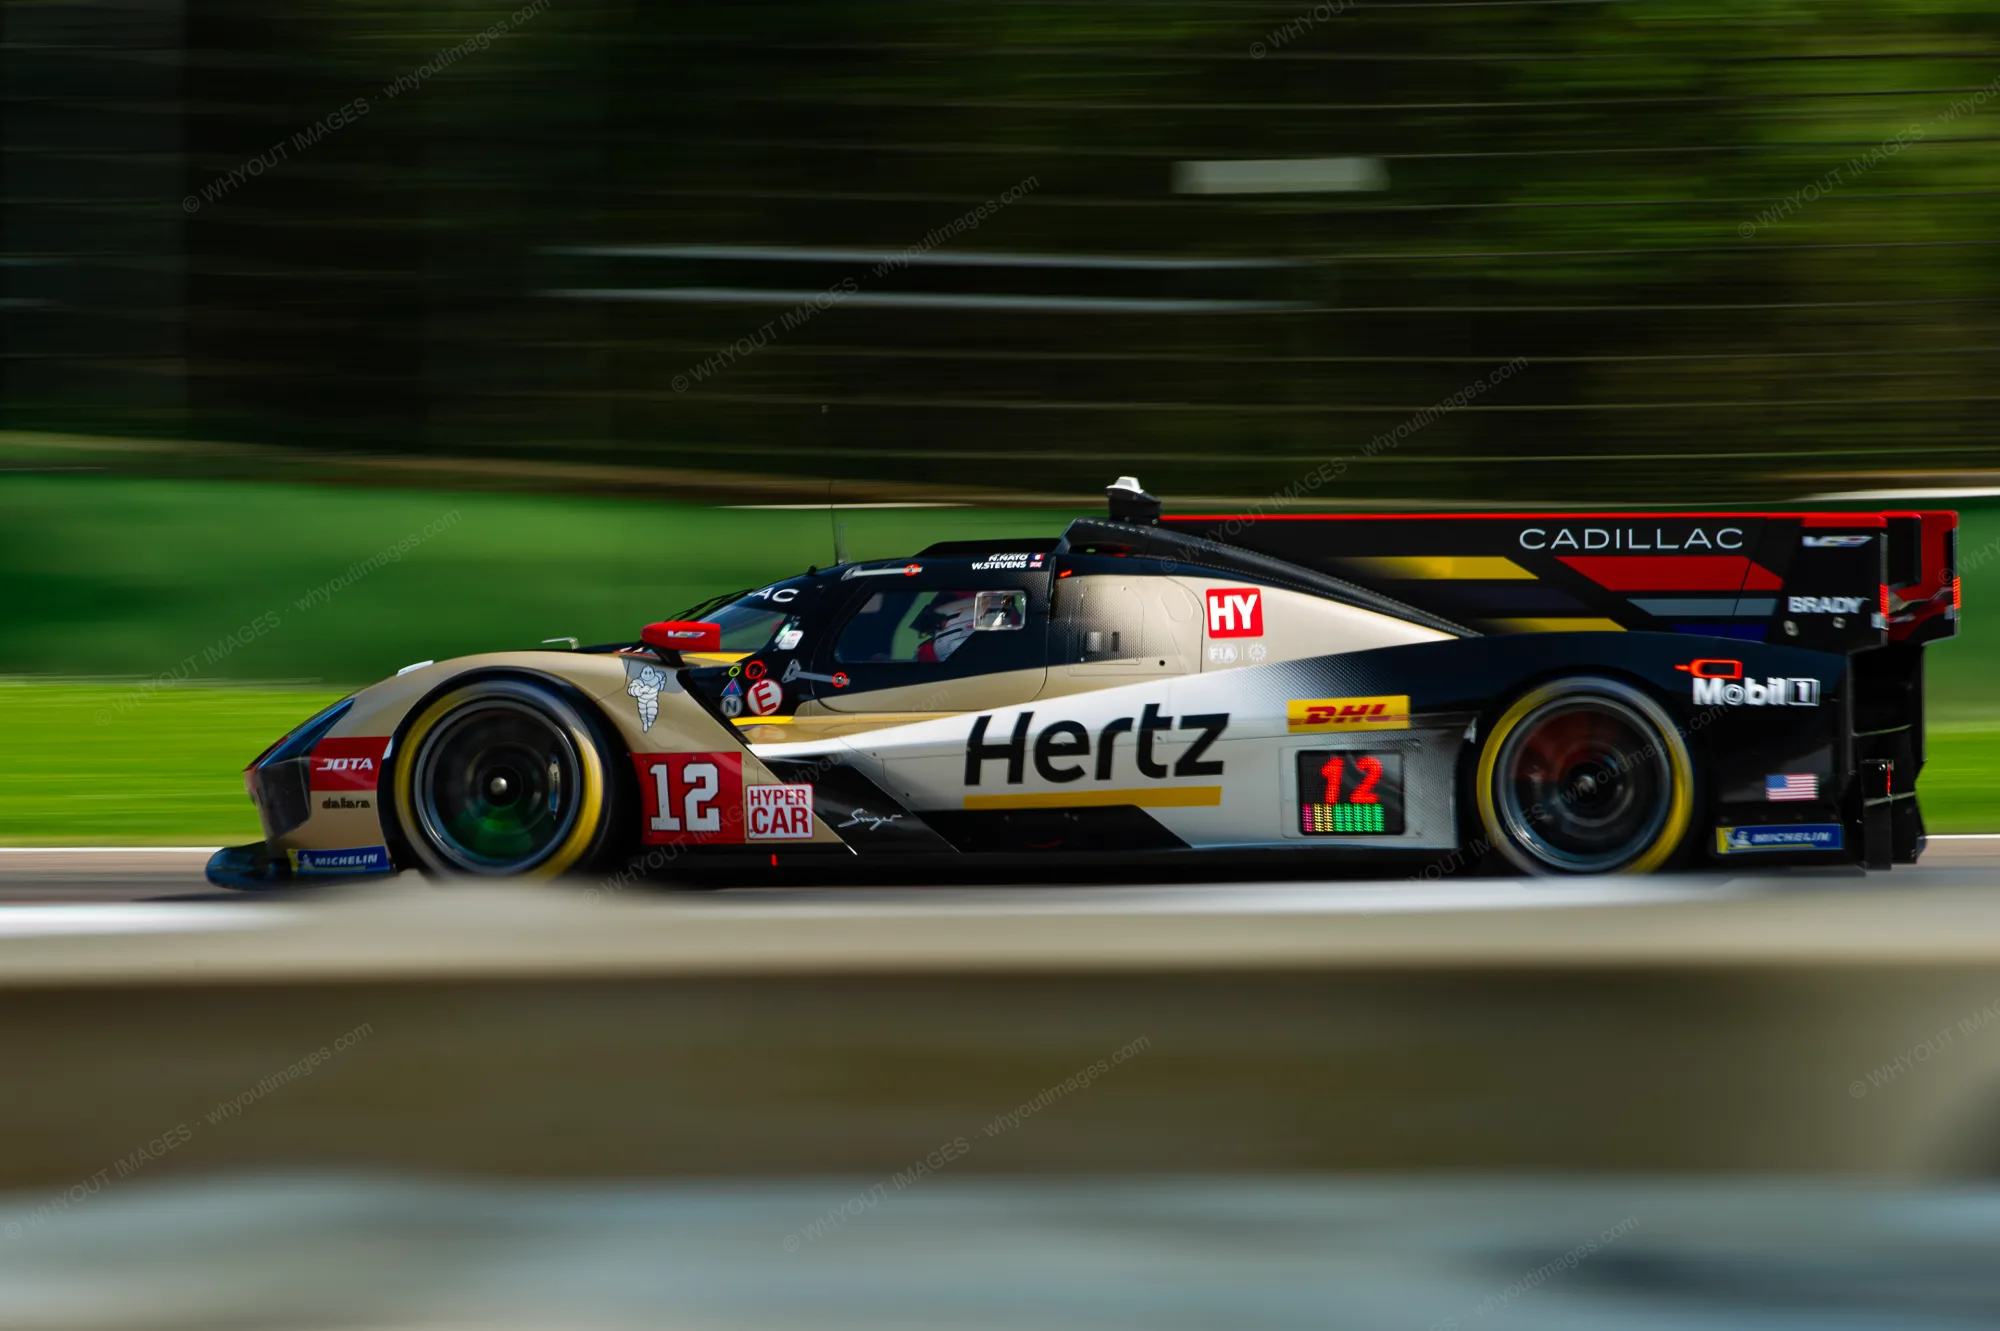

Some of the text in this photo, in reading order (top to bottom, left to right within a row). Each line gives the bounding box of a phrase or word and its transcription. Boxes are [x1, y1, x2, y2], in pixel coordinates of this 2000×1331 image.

[1519, 528, 1743, 550] CADILLAC
[971, 560, 1027, 570] W.STEVENS
[748, 586, 800, 603] AC
[1209, 594, 1258, 631] HY
[1788, 596, 1866, 614] BRADY
[1208, 646, 1236, 660] FIA
[753, 682, 777, 714] E
[1692, 677, 1787, 706] Mobil
[725, 700, 738, 713] N
[1304, 704, 1392, 724] DHL
[964, 703, 1230, 786] Hertz
[316, 758, 373, 771] JOTA
[1320, 756, 1384, 804] 12
[322, 797, 370, 809] dallara
[649, 762, 721, 833] 12
[750, 788, 808, 806] HYPER
[751, 807, 809, 835] CAR
[1752, 832, 1832, 843] MICHELIN
[315, 853, 378, 865] MICHELIN
